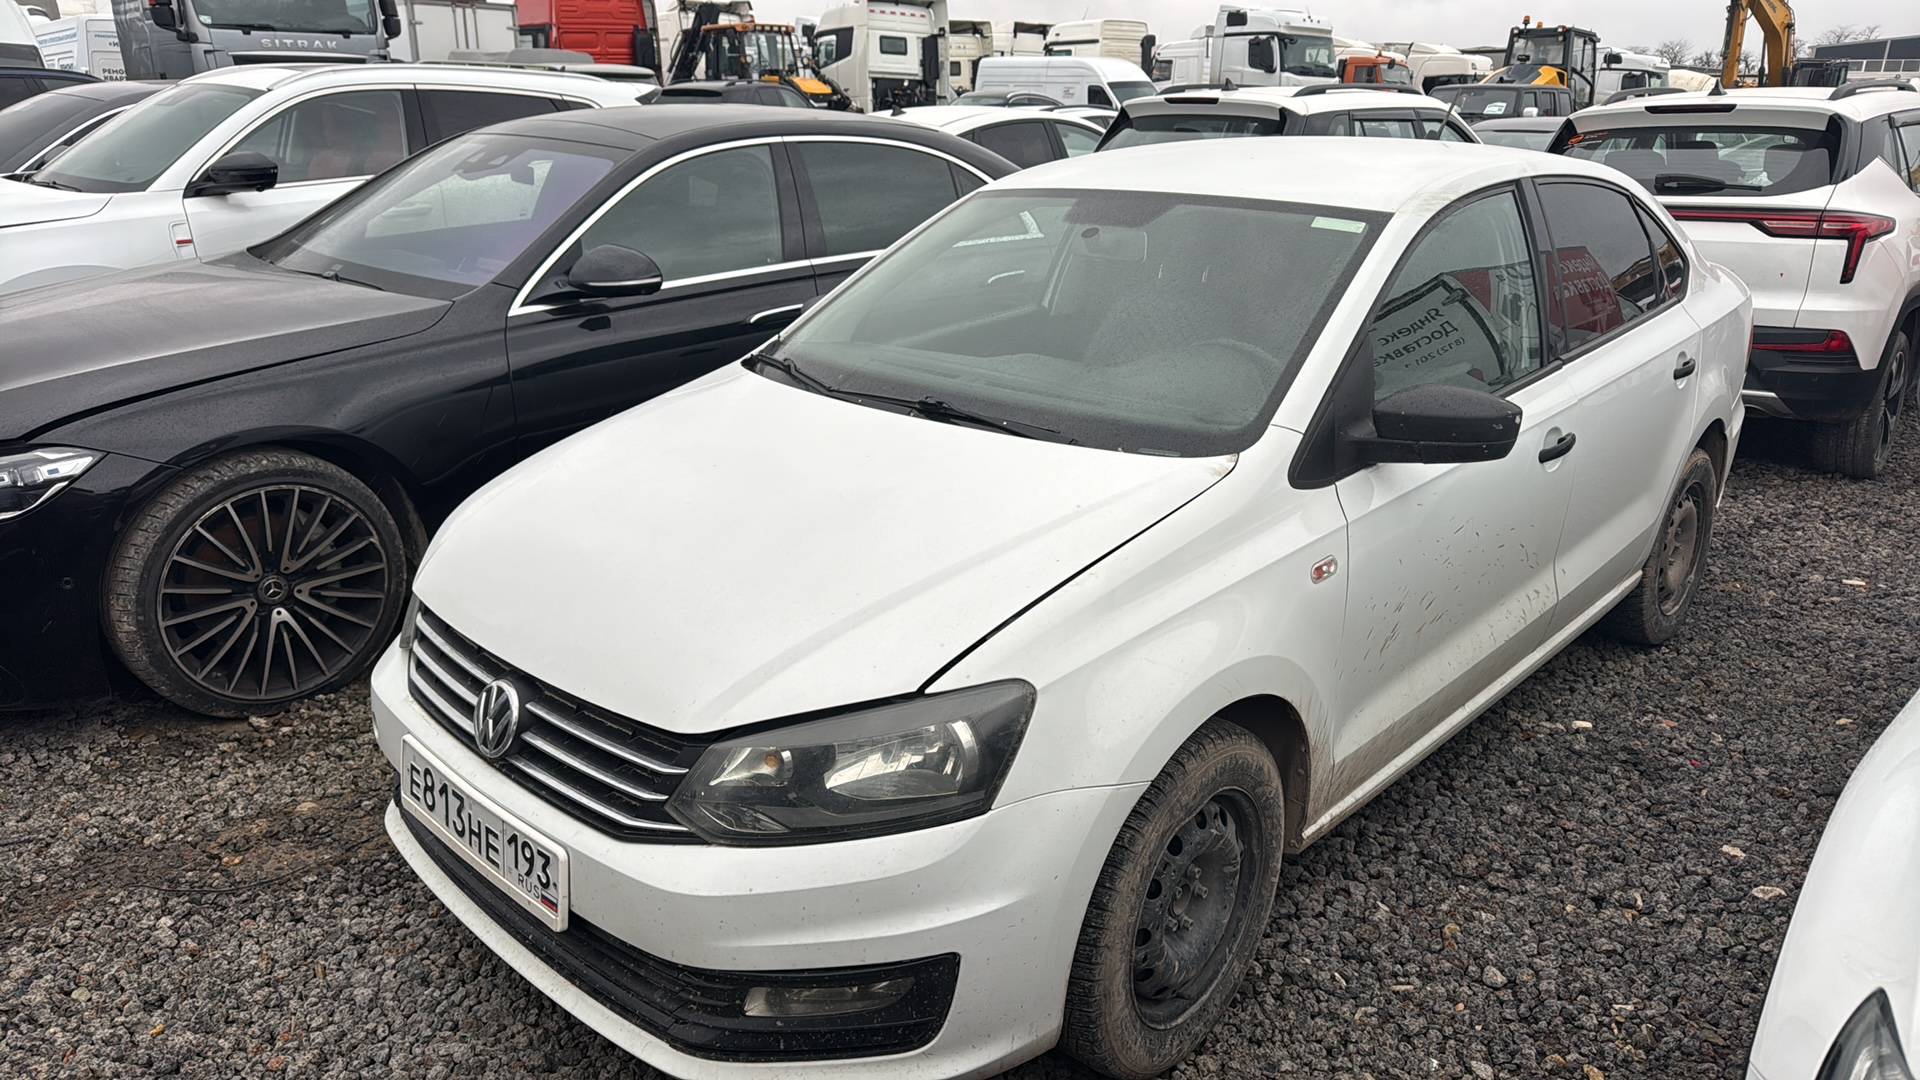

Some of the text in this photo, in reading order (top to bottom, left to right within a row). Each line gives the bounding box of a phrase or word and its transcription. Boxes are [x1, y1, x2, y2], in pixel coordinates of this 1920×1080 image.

[260, 39, 337, 50] SITRAK
[102, 67, 127, 75] РЕМО
[506, 832, 552, 890] 193
[517, 872, 541, 901] RUS
